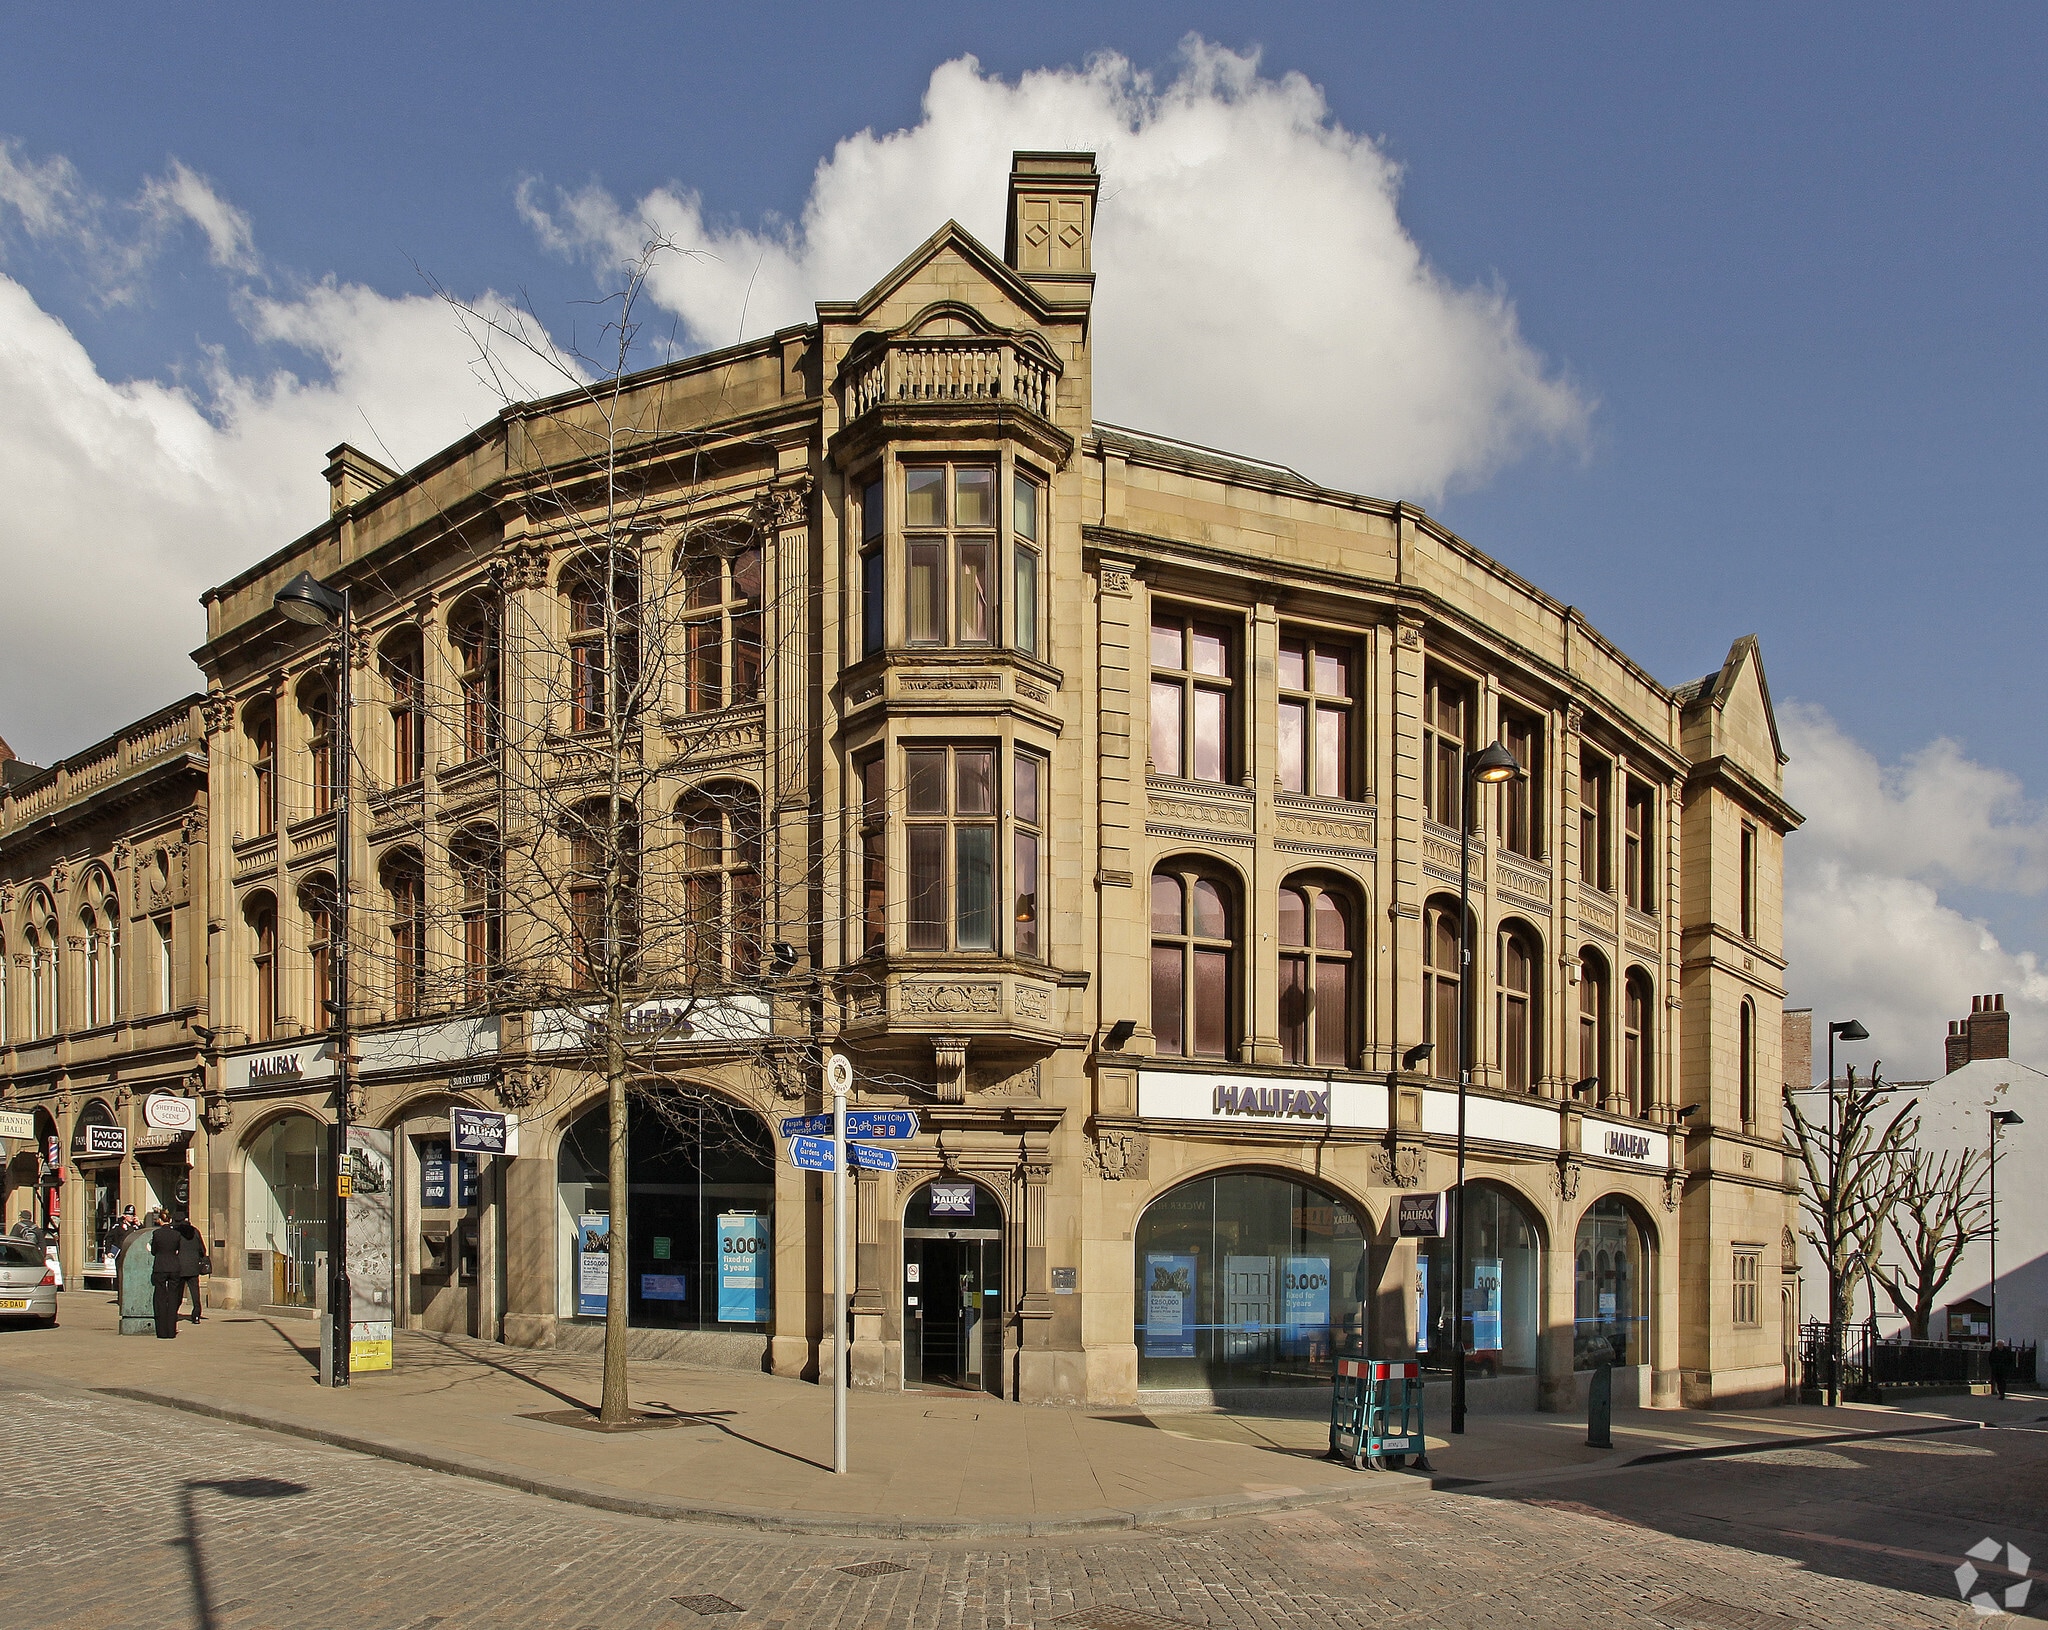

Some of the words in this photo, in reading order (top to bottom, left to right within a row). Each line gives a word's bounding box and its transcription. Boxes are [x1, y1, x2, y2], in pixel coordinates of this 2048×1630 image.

[588, 1008, 695, 1032] HLIFAX
[250, 1053, 299, 1077] HALIFAX
[453, 1075, 472, 1086] SURREY
[472, 1073, 490, 1084] STREET
[1214, 1085, 1329, 1118] HALIFAX
[156, 1105, 186, 1113] SHEFFIELD
[162, 1112, 180, 1120] SCENE
[873, 1114, 887, 1122] SHU
[888, 1113, 906, 1123] (City)
[5, 1125, 24, 1134] HALL
[460, 1124, 504, 1139] HALIFAX
[786, 1127, 812, 1135] Hathersage
[93, 1131, 122, 1140] TAYLOR
[93, 1140, 122, 1149] TAYLOR
[803, 1140, 817, 1149] Peace
[1606, 1131, 1650, 1157] HALIFAX
[800, 1147, 820, 1157] Gardens
[868, 1150, 884, 1159] Courts
[800, 1157, 809, 1165] The
[810, 1159, 823, 1167] Moor
[858, 1156, 876, 1165] Victoria
[876, 1159, 891, 1168] Quays
[932, 1196, 971, 1205] HALIFAX
[1401, 1209, 1433, 1221] HALIFAX
[723, 1237, 767, 1254] 3.00%
[729, 1265, 750, 1273] years
[1286, 1274, 1328, 1290] 3.00%
